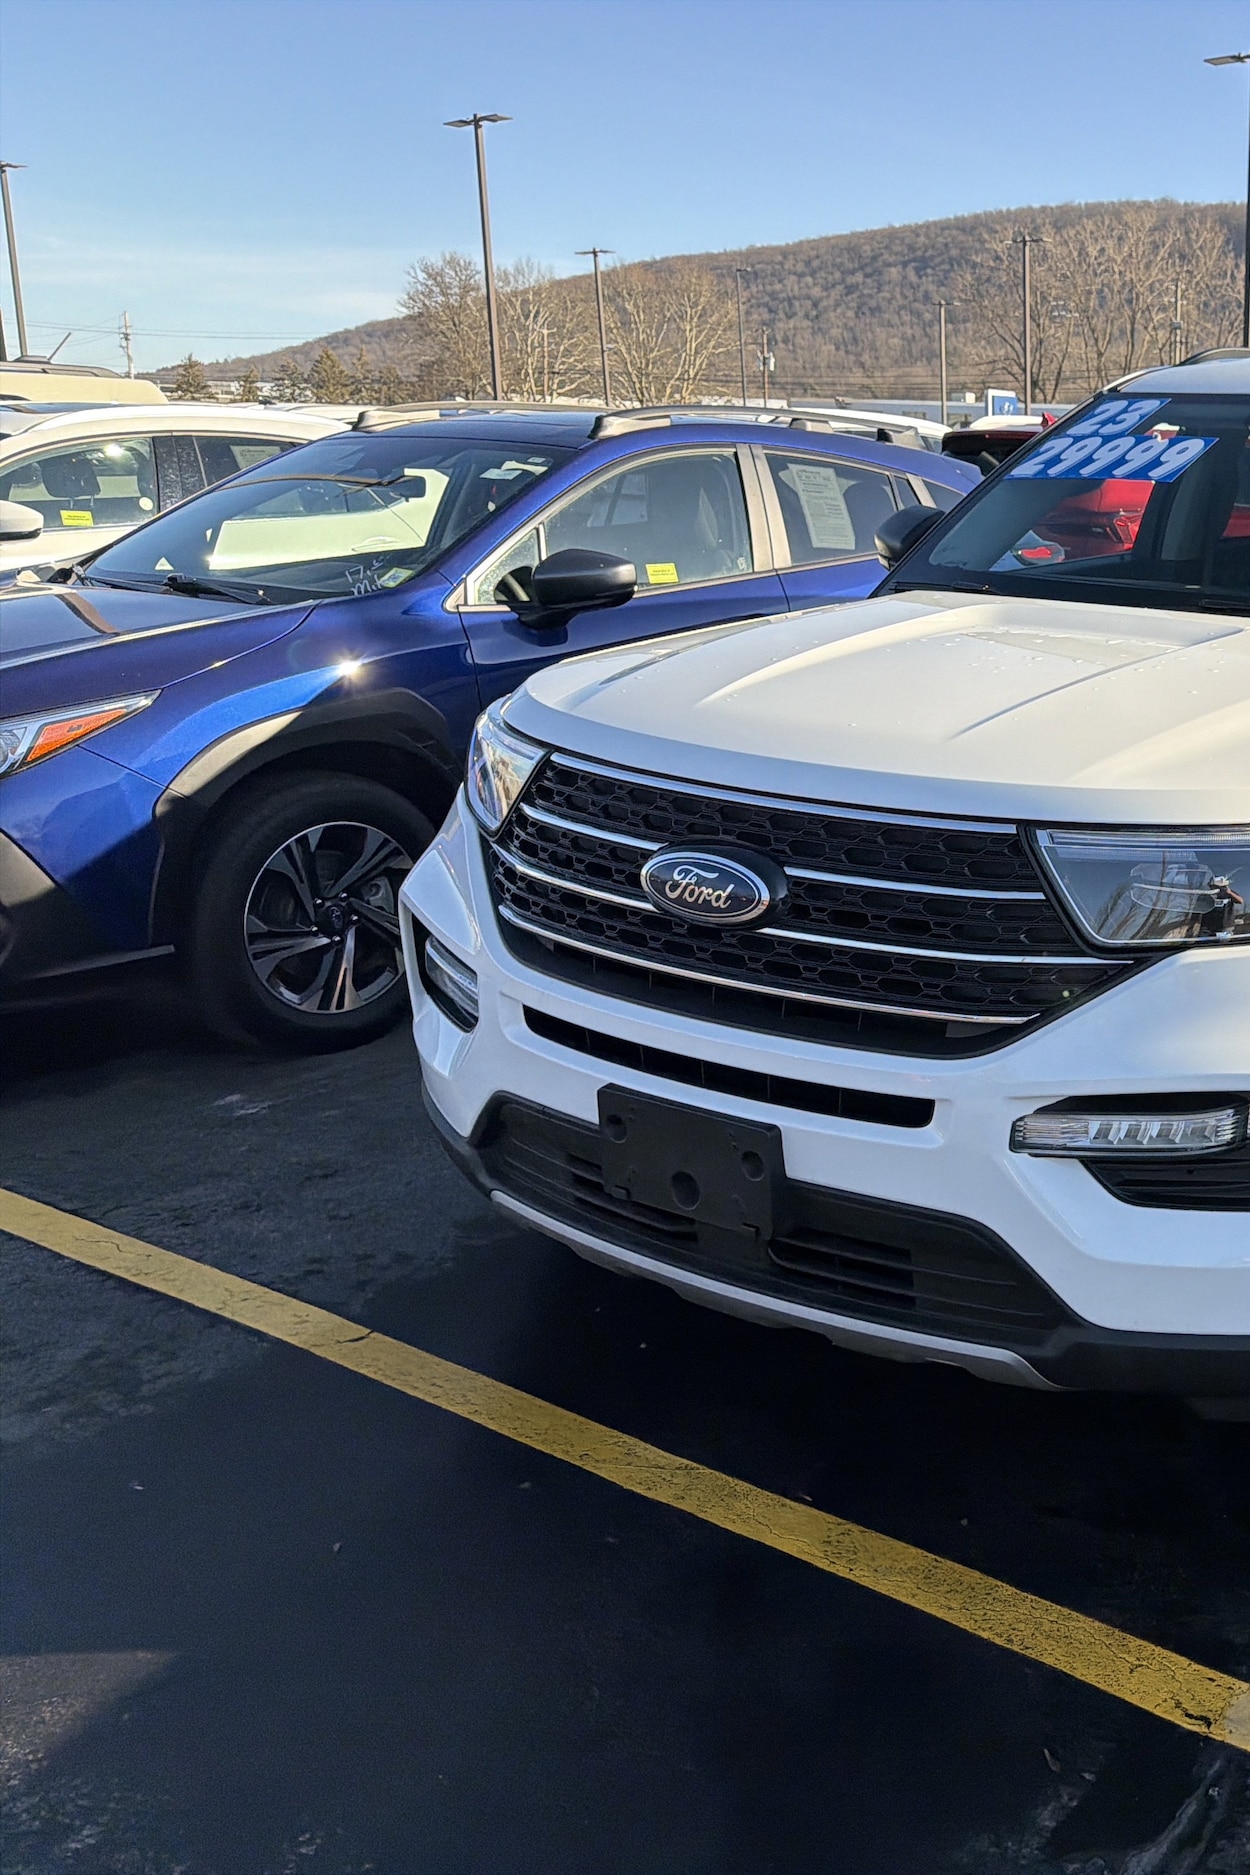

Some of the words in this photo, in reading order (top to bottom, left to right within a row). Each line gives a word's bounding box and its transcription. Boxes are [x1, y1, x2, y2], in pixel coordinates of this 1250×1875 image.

[1065, 400, 1161, 436] 23
[1010, 436, 1205, 478] 29999
[665, 865, 735, 909] Ford
